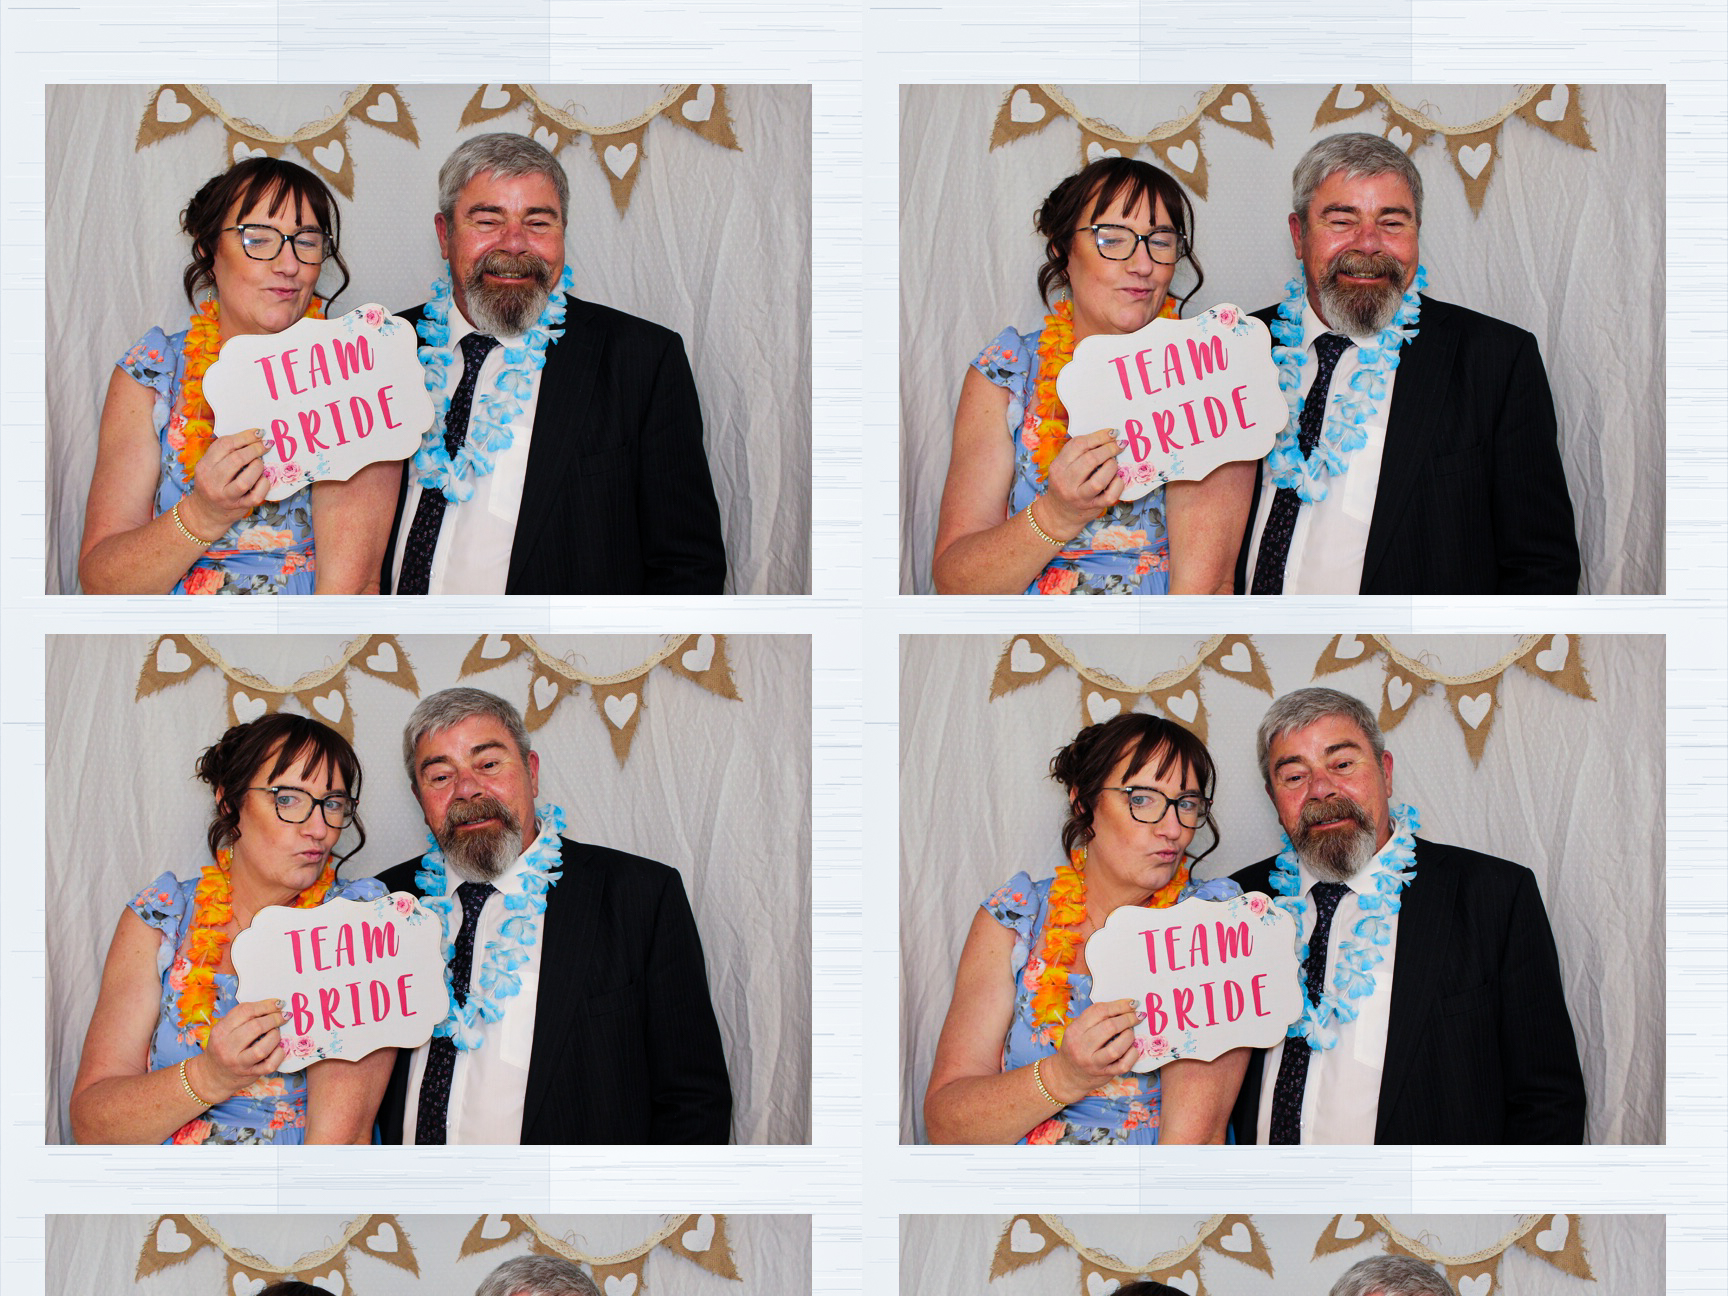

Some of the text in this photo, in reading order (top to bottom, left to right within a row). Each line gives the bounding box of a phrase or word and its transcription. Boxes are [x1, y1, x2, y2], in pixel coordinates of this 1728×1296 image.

[254, 334, 375, 402] TEAM
[1108, 334, 1229, 402] TEAM
[270, 384, 403, 464] BRIDE
[1124, 384, 1257, 464] BRIDE
[283, 920, 400, 975] TEAM
[1137, 920, 1254, 975] TEAM
[290, 973, 418, 1038] BRIDE
[1144, 973, 1272, 1038] BRIDE
